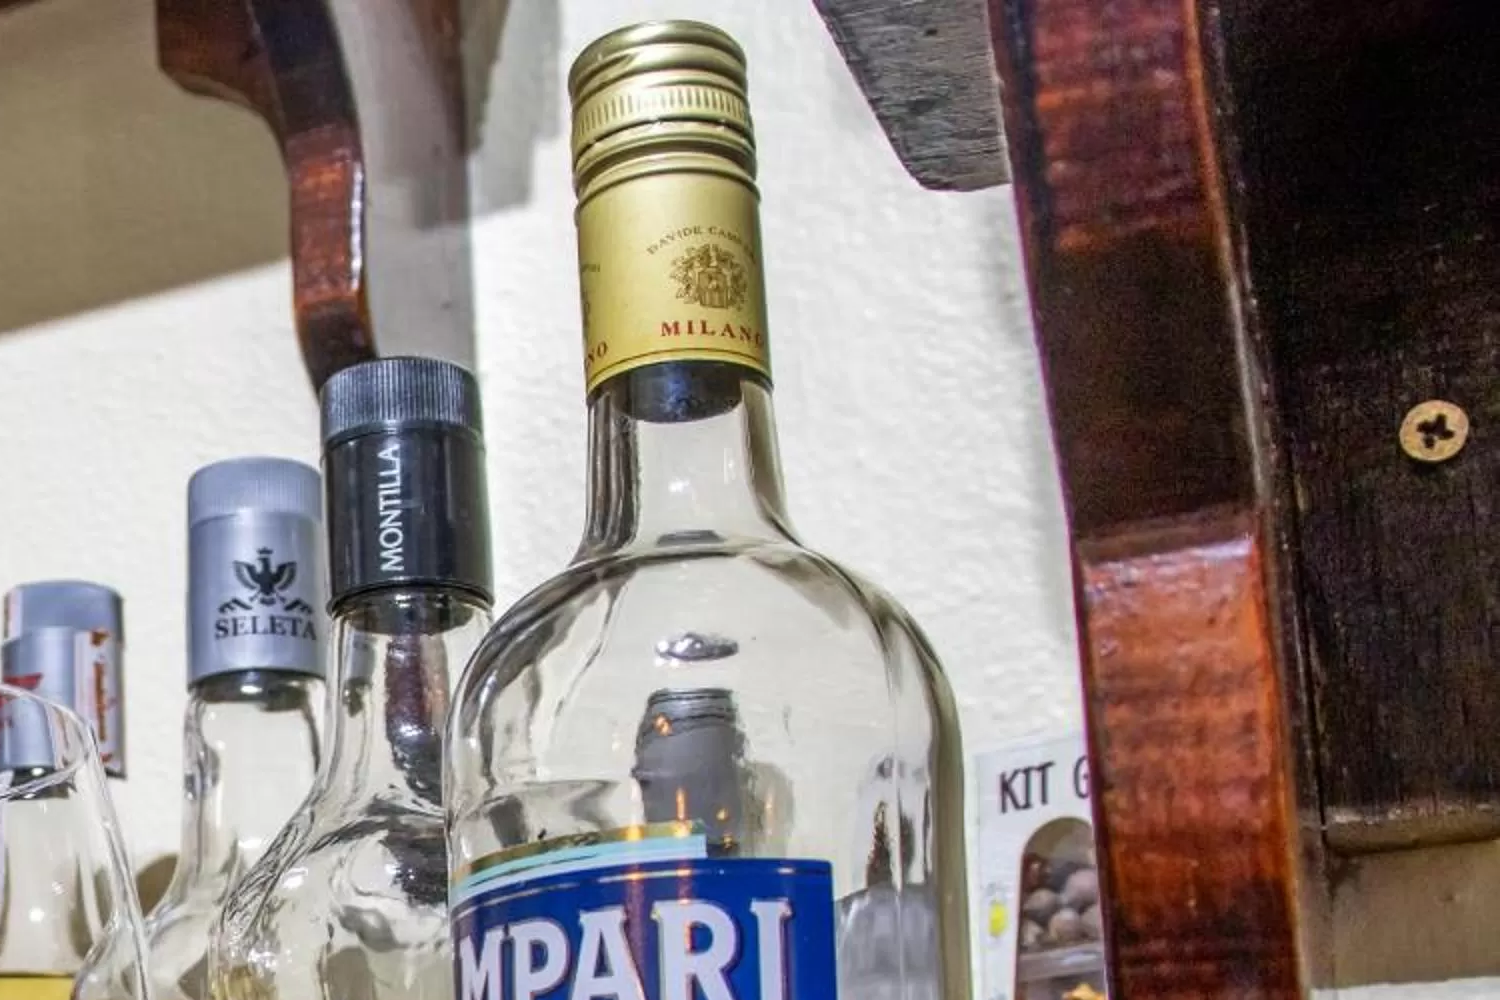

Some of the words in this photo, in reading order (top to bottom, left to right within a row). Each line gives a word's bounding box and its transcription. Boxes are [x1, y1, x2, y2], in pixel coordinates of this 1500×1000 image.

[377, 442, 405, 572] MONTILLA
[214, 614, 318, 642] SELETA
[998, 760, 1056, 814] KIT
